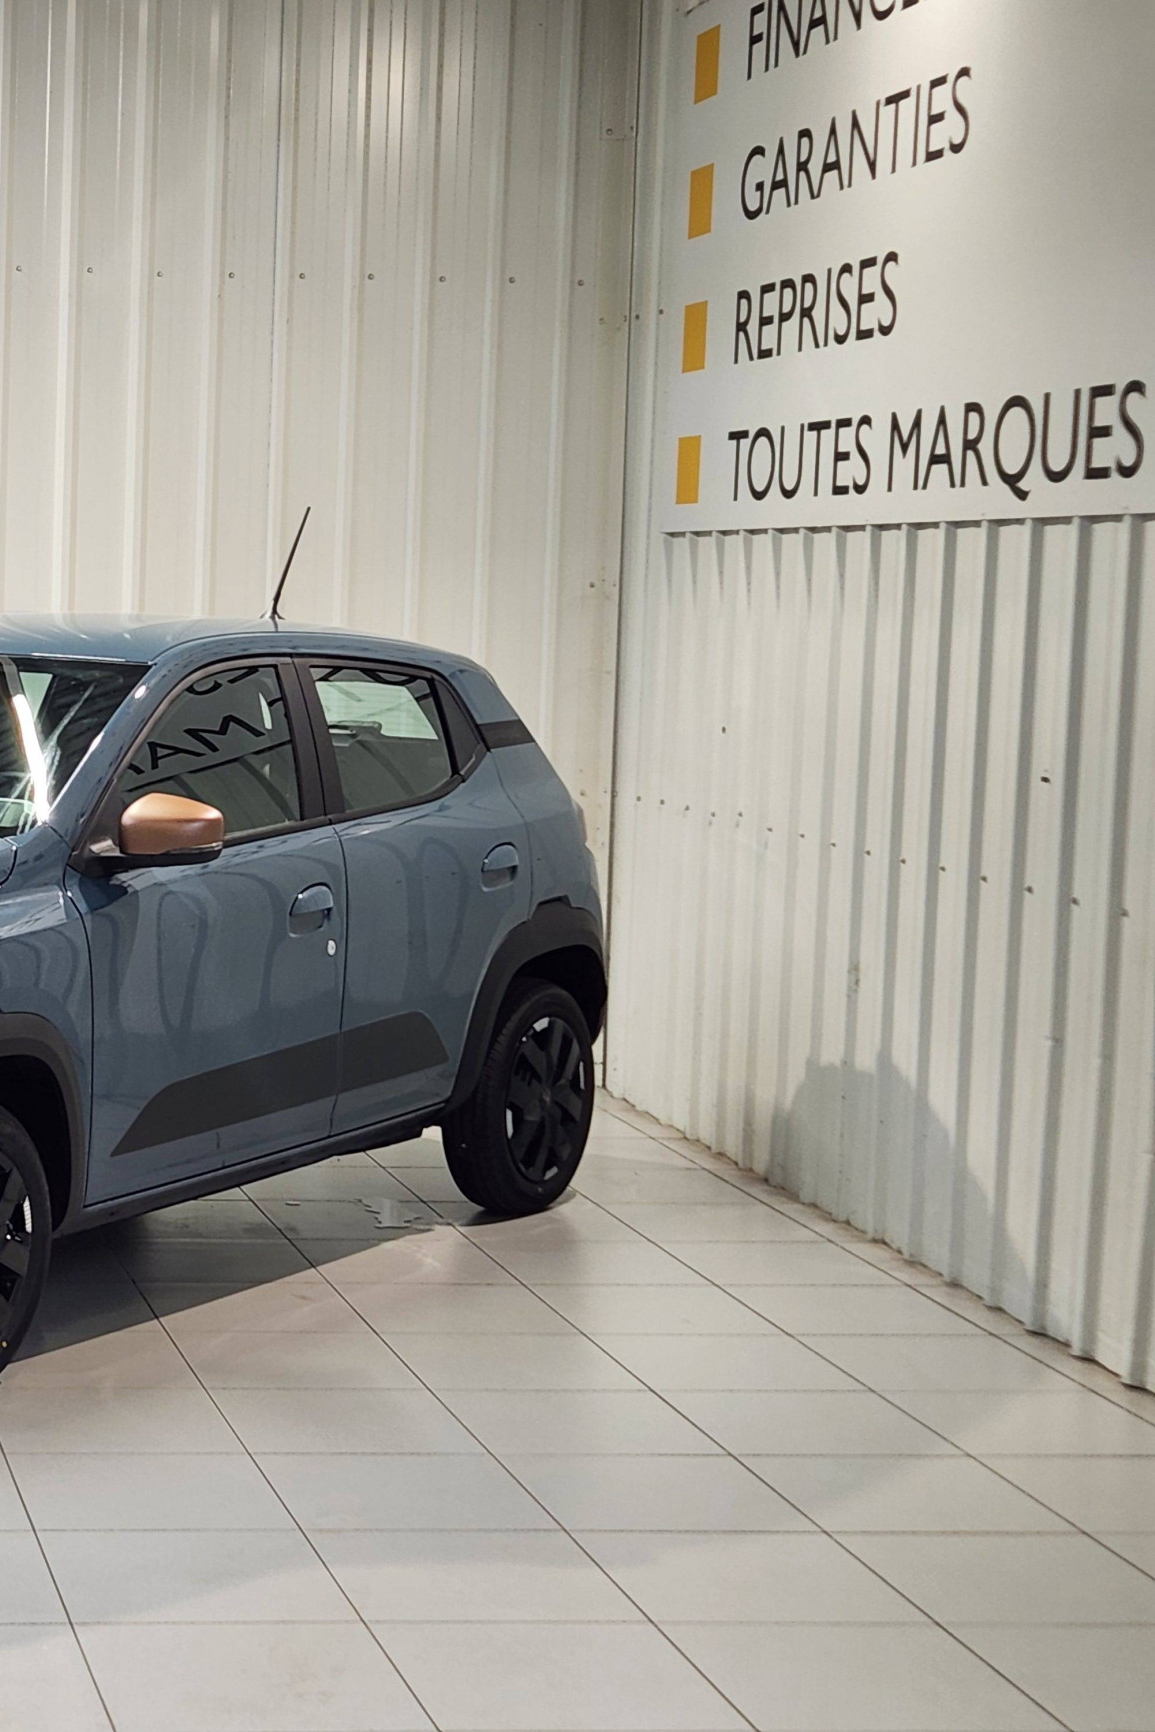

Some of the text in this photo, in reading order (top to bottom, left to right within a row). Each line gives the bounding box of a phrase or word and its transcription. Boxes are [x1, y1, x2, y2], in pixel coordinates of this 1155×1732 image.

[740, 66, 972, 221] GARANTIES
[733, 250, 899, 365] REPRISES
[727, 379, 1148, 502] TOUTES MARQUES
